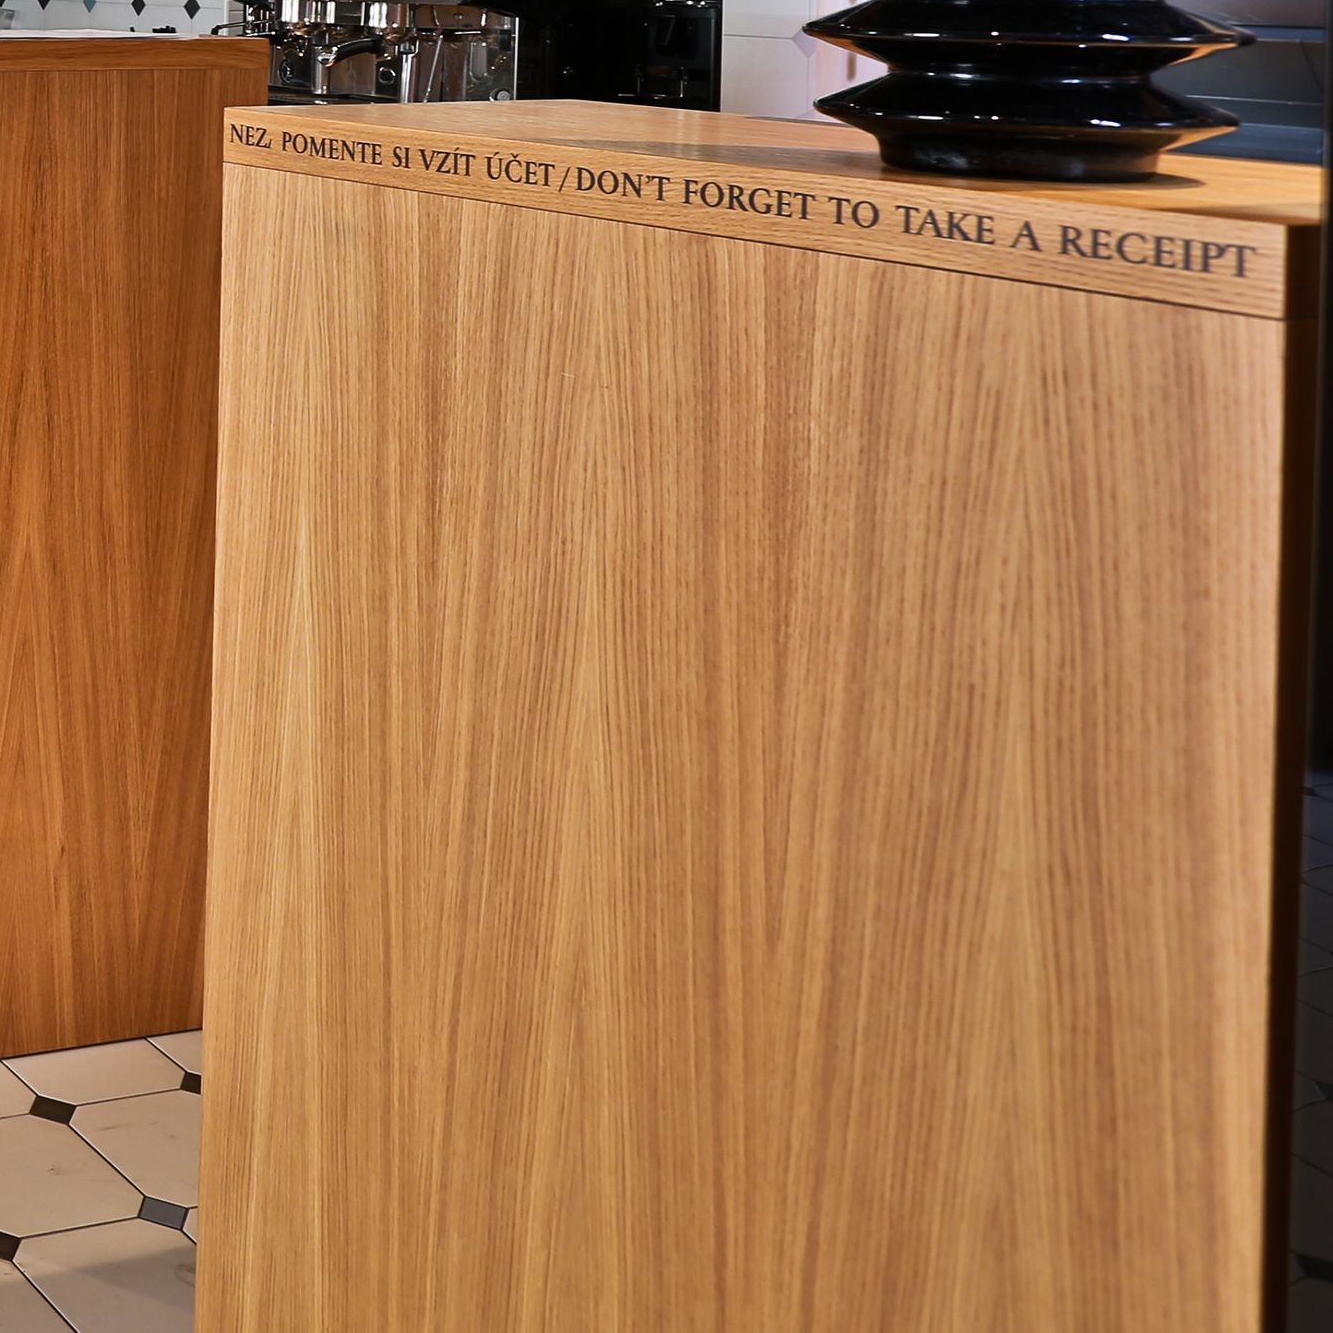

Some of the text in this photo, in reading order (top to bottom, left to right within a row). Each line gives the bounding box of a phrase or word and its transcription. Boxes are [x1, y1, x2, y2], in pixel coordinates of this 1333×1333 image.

[391, 145, 411, 169] SI
[419, 147, 476, 177] VZÍT
[683, 179, 817, 220] FORGET
[827, 195, 880, 229] TO
[894, 204, 996, 246] TAKE
[1009, 220, 1043, 252] A
[1058, 224, 1257, 278] RECEIPT
